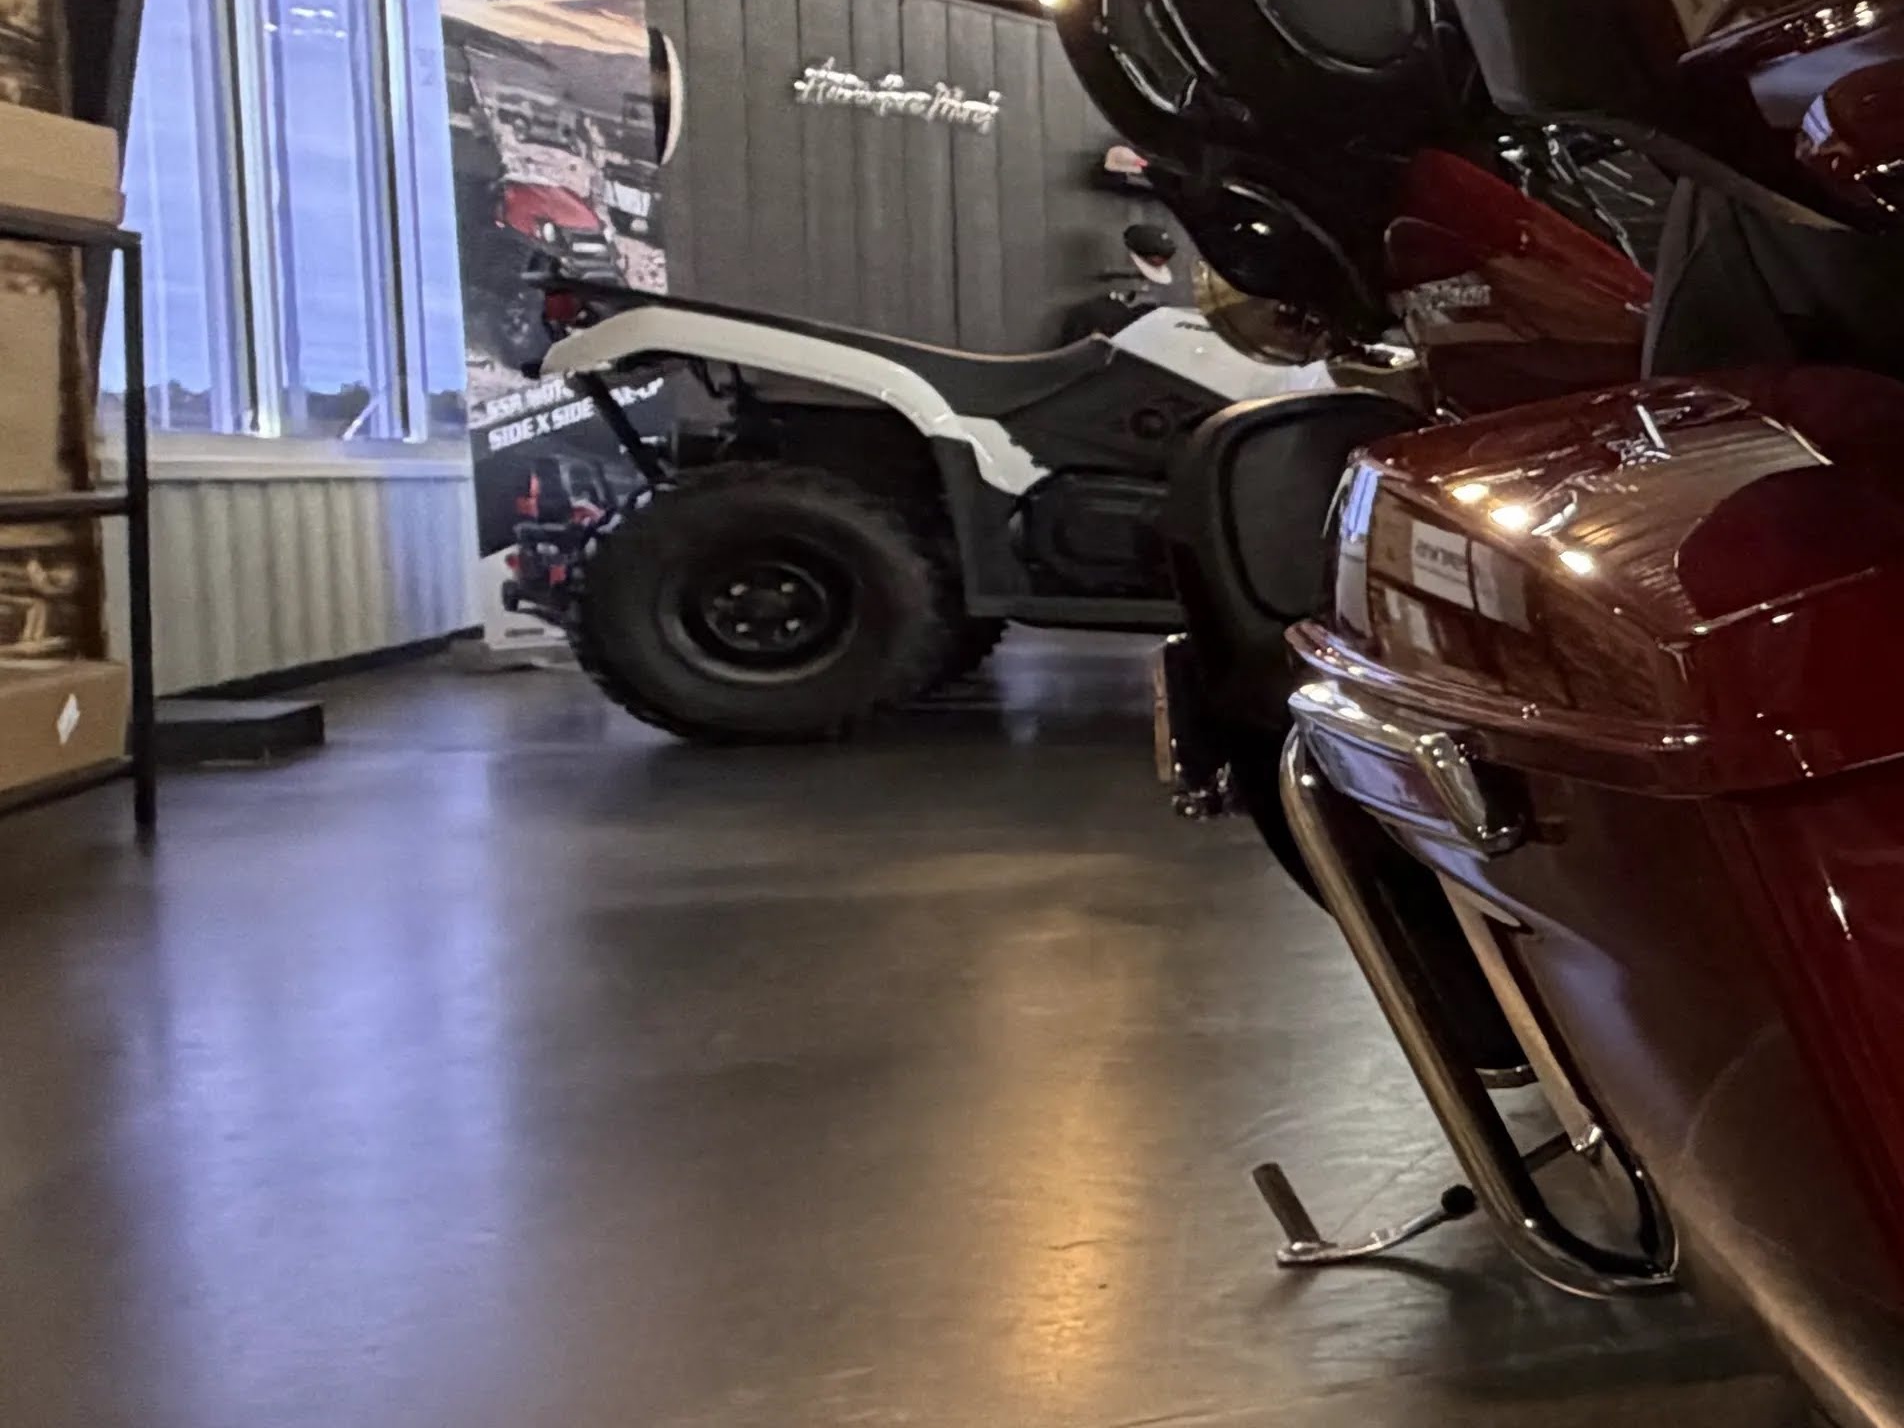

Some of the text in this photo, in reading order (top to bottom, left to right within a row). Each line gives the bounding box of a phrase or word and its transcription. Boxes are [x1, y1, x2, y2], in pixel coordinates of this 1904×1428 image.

[488, 417, 535, 451] SIDE
[536, 412, 550, 435] X
[551, 396, 596, 430] SIDE
